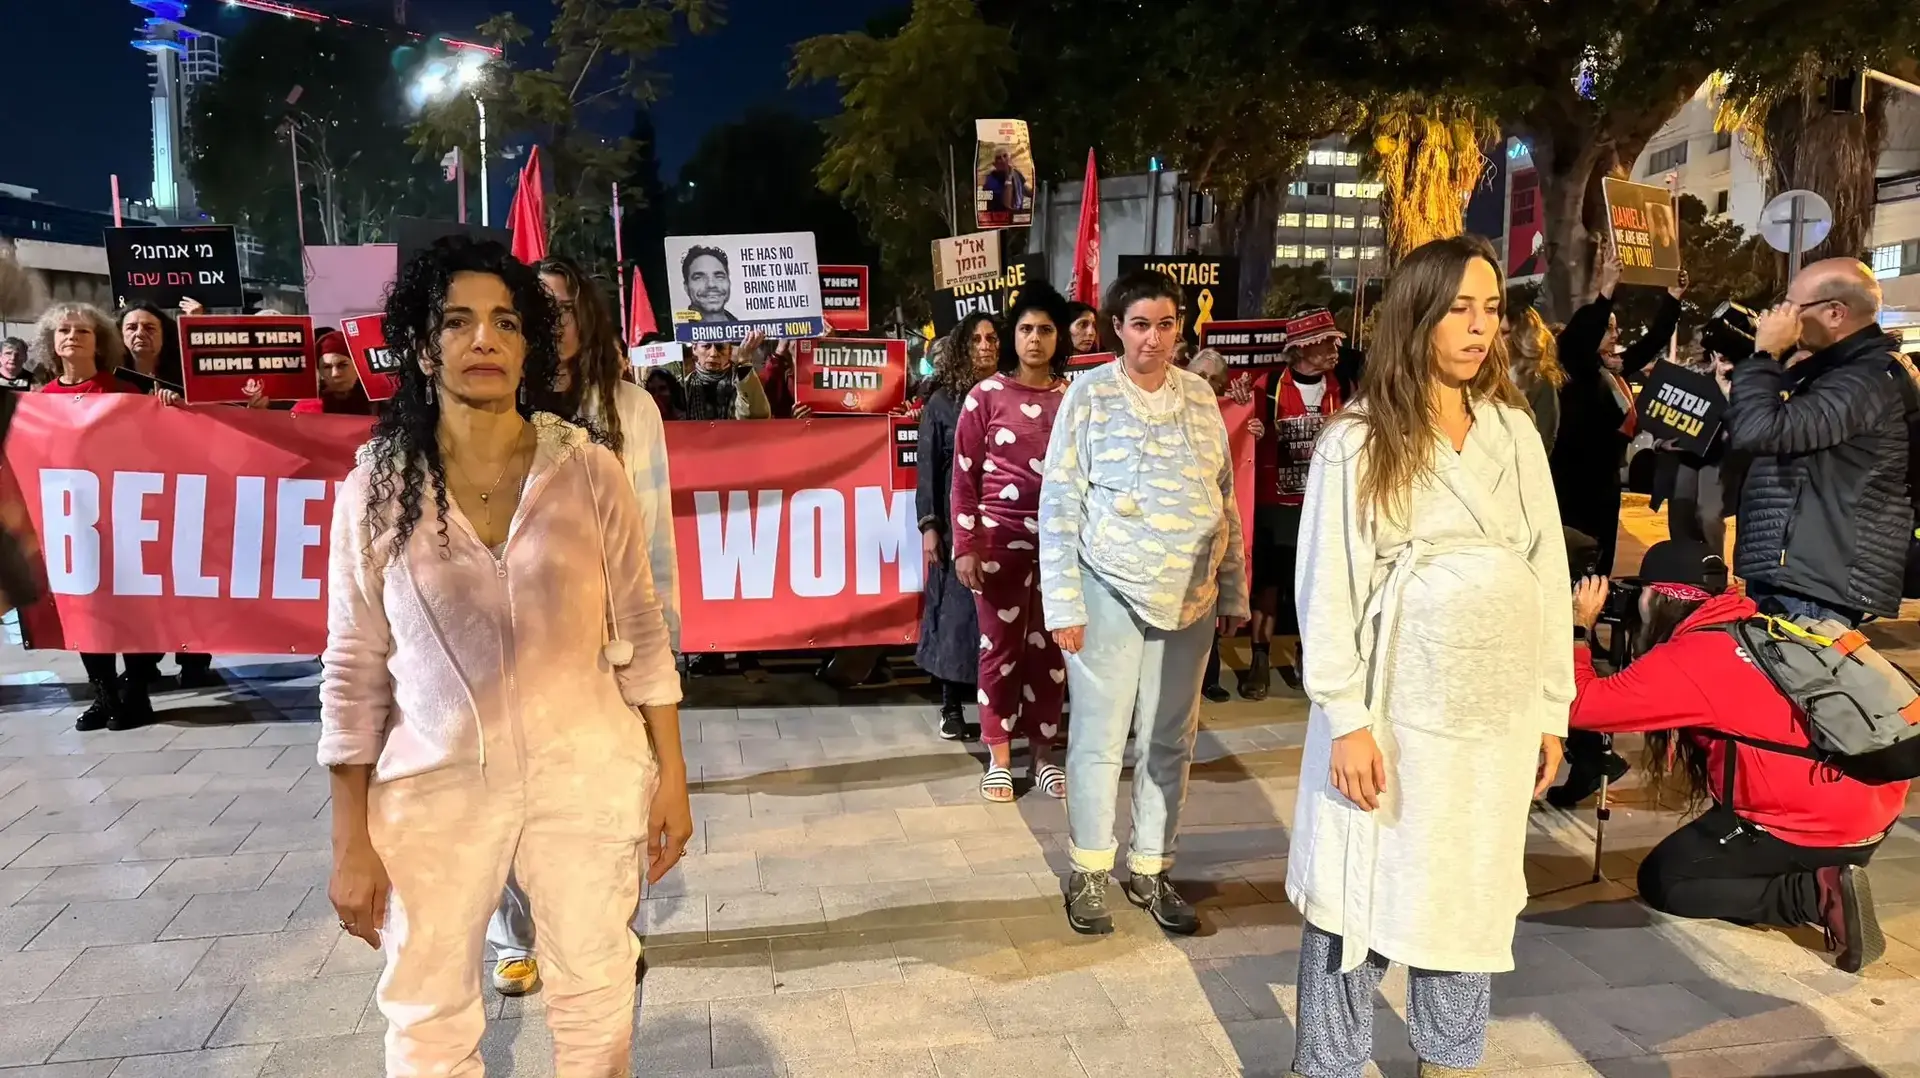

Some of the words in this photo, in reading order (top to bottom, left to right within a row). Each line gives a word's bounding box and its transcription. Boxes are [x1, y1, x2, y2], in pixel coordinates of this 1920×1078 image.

[1612, 205, 1648, 230] DANIELA
[1615, 229, 1625, 243] WE
[1625, 230, 1636, 244] ARE
[1636, 231, 1650, 247] HERE
[131, 244, 189, 259] אנחנו?
[195, 244, 213, 258] מי
[741, 248, 754, 261] HE
[757, 247, 778, 260] HAS
[780, 246, 793, 259] NO
[1618, 244, 1634, 266] FOR
[1634, 246, 1653, 268] YOU!
[742, 264, 767, 277] TIME
[770, 263, 782, 276] TO
[783, 262, 812, 276] WAIT.
[956, 255, 987, 275] הזמן
[127, 271, 160, 286] שם!
[167, 272, 193, 285] הם
[199, 270, 225, 285] אם
[823, 277, 858, 288] THEM
[744, 280, 775, 294] BRING
[777, 279, 797, 293] HIM
[746, 297, 776, 310] HOME
[778, 295, 809, 309] ALIVE!
[824, 296, 861, 307] NOW!
[190, 332, 250, 345] BRING
[255, 331, 302, 344] THEM
[692, 326, 723, 340] BRING
[785, 321, 812, 335] NOW!
[1207, 333, 1250, 345] BRING
[199, 358, 253, 371] HOME
[259, 355, 307, 369] NOW!
[852, 348, 888, 367] נגמר
[822, 367, 877, 389] הזמן!
[1657, 382, 1712, 417] עסקה
[1645, 399, 1705, 437] עכשיו!
[39, 468, 342, 600] BELIE
